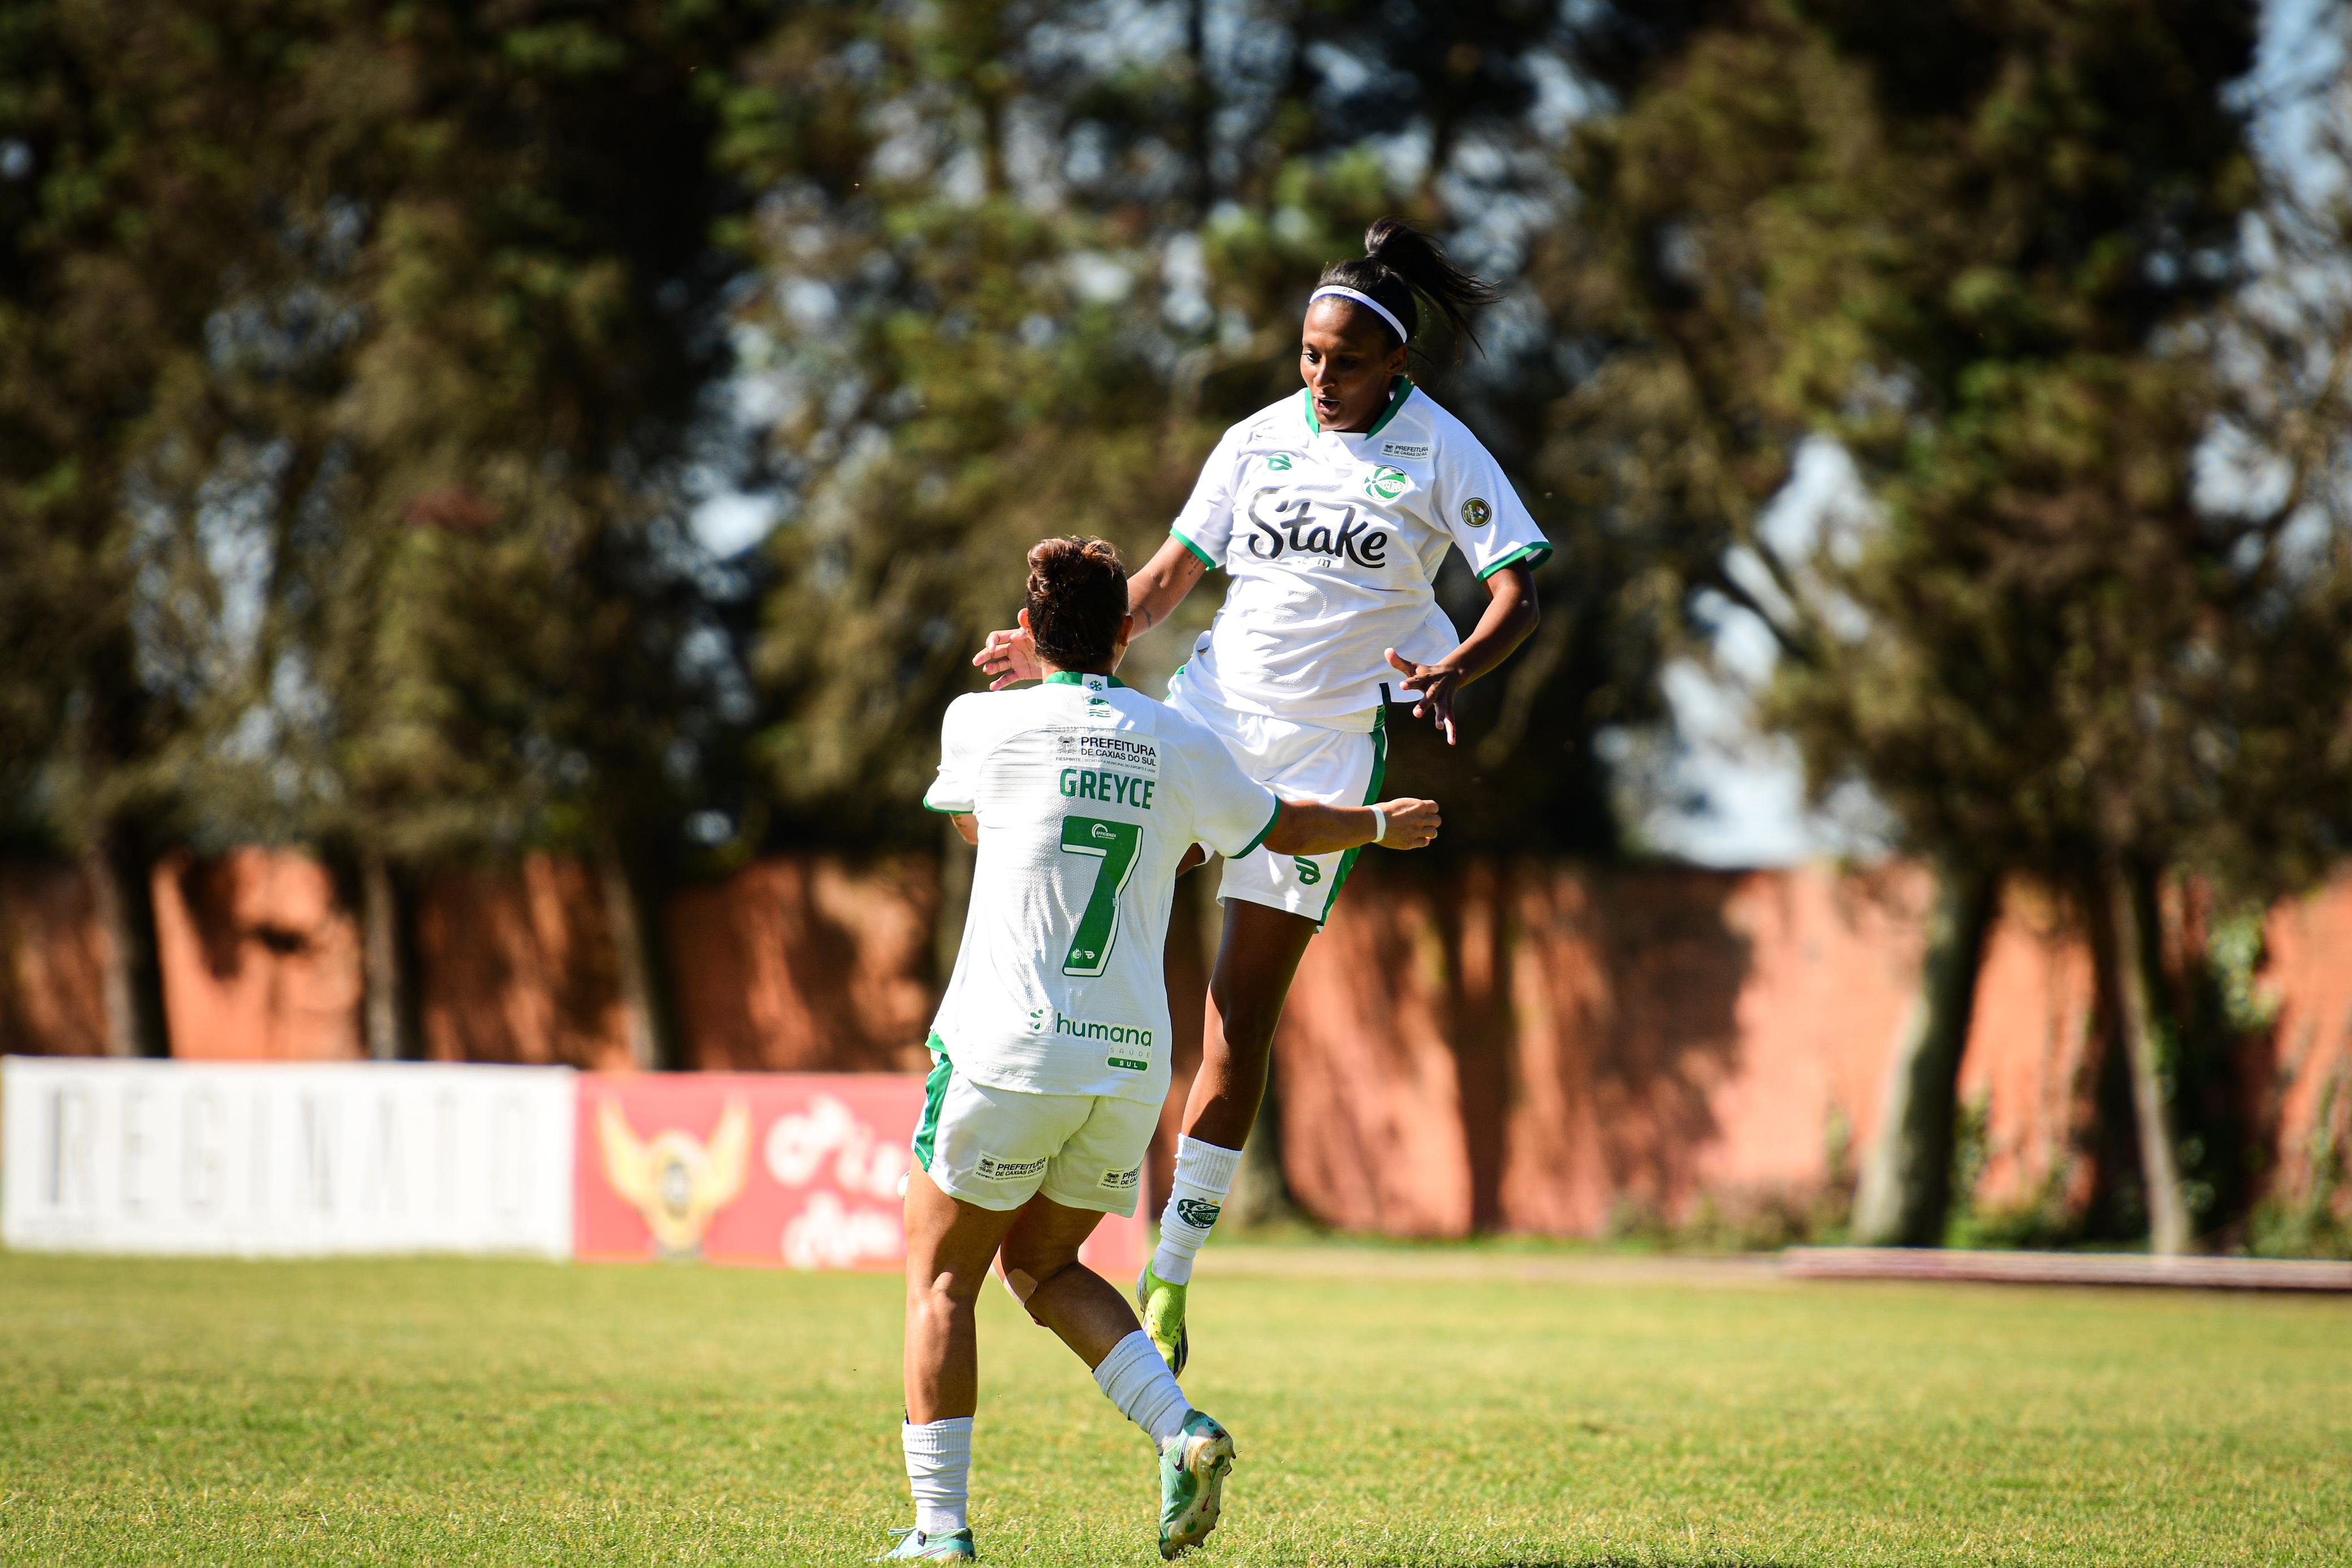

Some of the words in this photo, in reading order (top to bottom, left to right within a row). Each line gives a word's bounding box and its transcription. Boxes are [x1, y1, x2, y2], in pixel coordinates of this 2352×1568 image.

[1248, 488, 1387, 569] Stake
[1080, 737, 1156, 757] PREFEITURA
[1095, 749, 1126, 760] CAXIAS
[1127, 753, 1140, 763] DO
[1142, 756, 1156, 766] SUL
[1060, 768, 1156, 810] GREYCE
[1060, 815, 1143, 977] 7
[1056, 1012, 1152, 1047] humana
[1110, 1047, 1151, 1058] SAÚDE
[1119, 1060, 1138, 1068] SUL
[997, 1156, 1046, 1171] PREFEITURA
